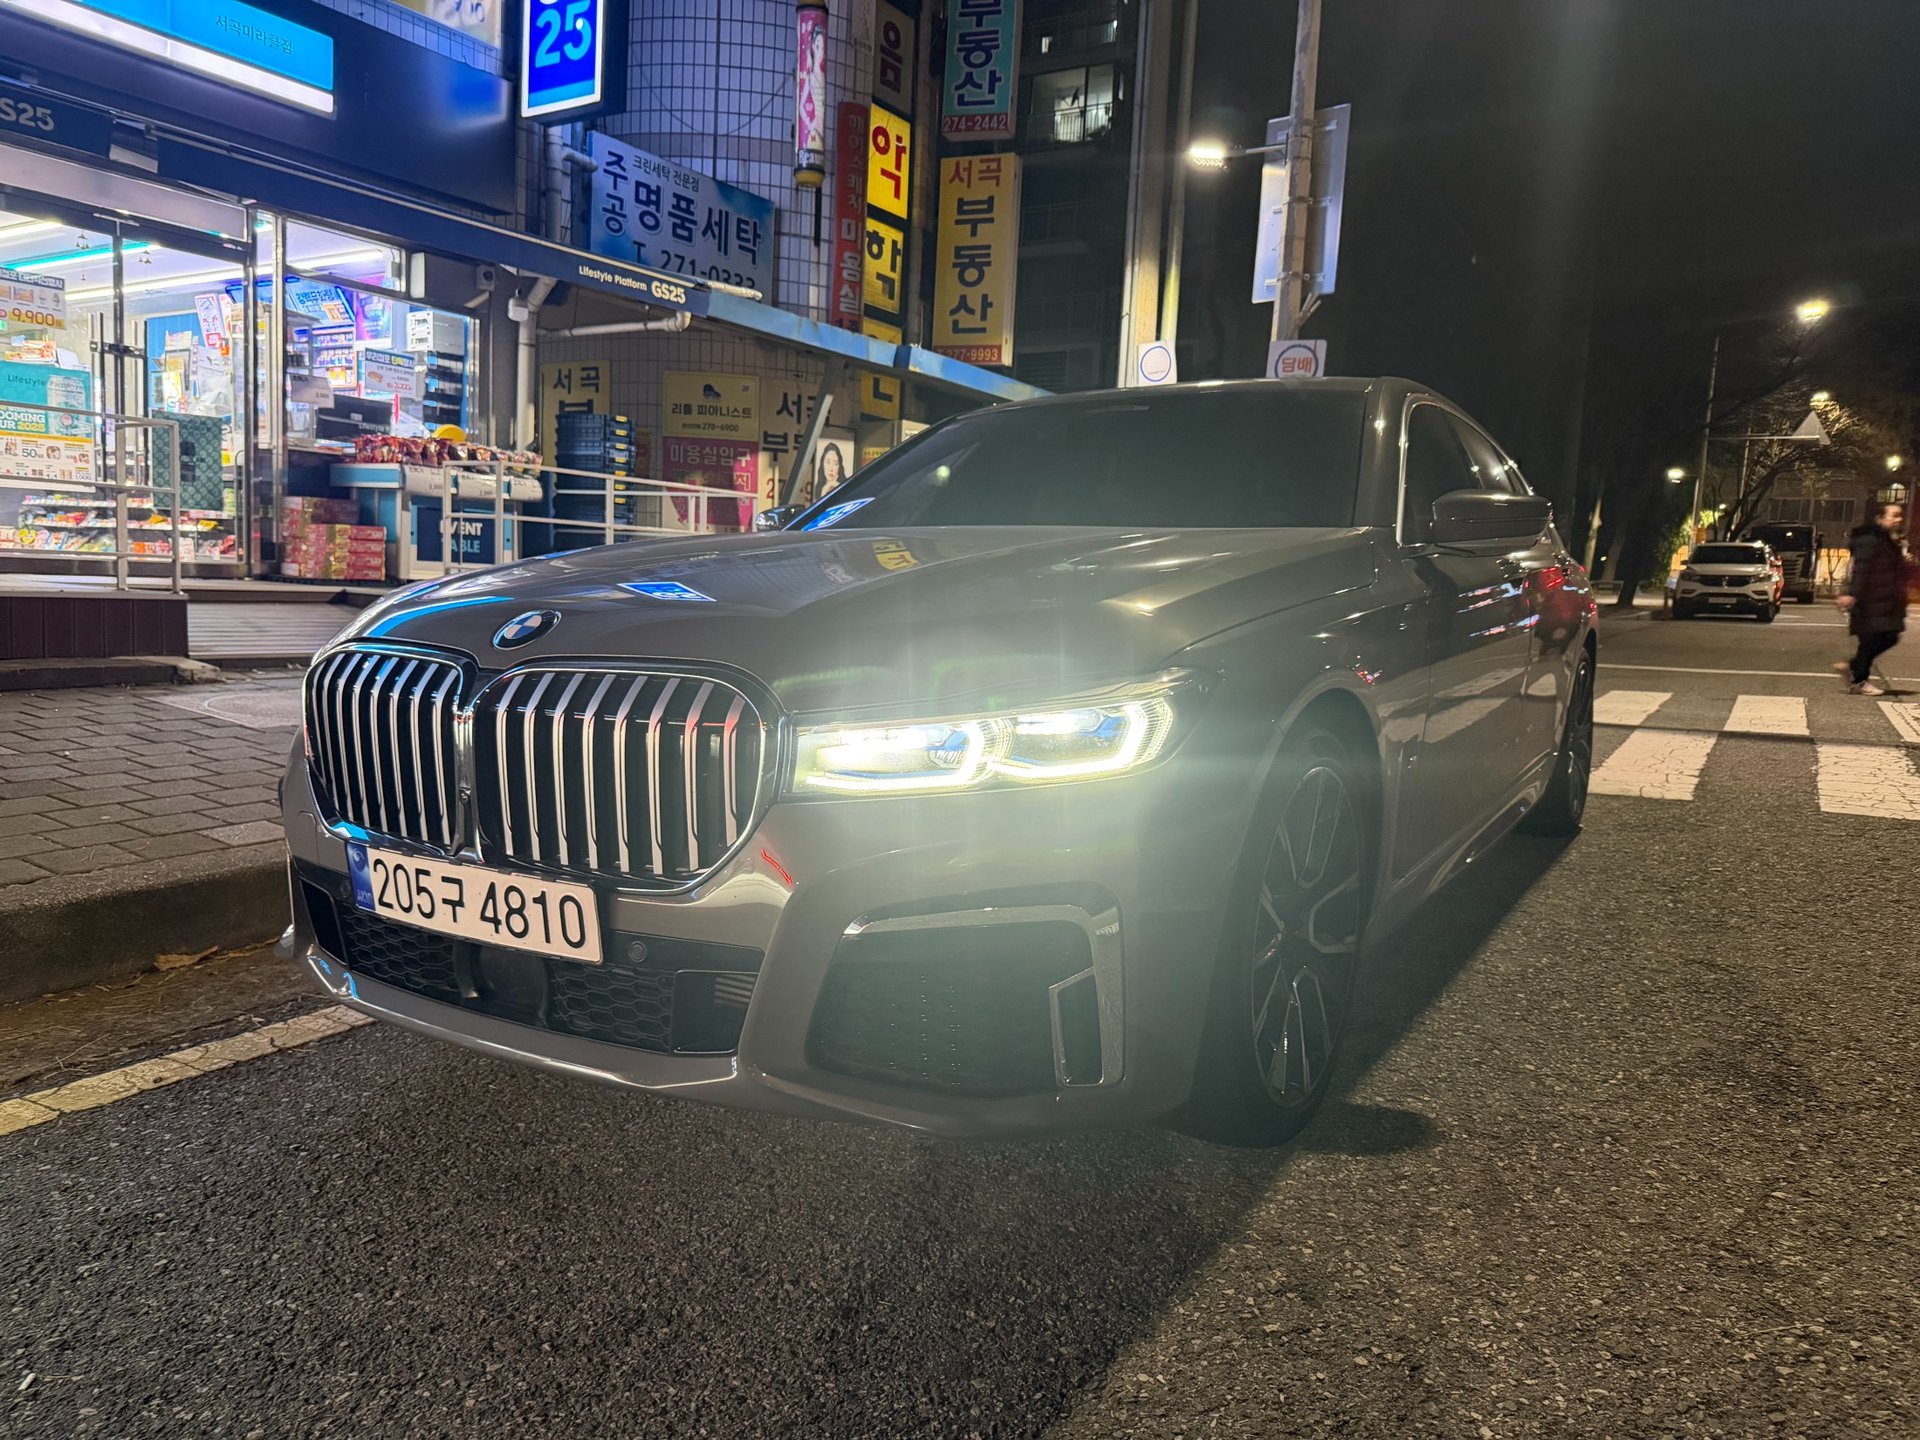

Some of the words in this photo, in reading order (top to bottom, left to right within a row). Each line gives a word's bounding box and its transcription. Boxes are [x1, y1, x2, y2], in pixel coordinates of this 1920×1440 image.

[216, 15, 293, 56] 서곡미라클점
[535, 0, 592, 68] 25
[944, 114, 1008, 132] 274-2442
[632, 154, 671, 182] 크린세탁
[949, 157, 1002, 188] 서곡
[634, 180, 762, 266] 명품세탁
[840, 218, 862, 315] 미용실
[949, 195, 994, 334] 부동산
[579, 265, 613, 283] Lifestyle
[614, 274, 648, 292] Platform
[651, 280, 686, 305] GS25
[1281, 356, 1313, 373] 담배
[7, 374, 46, 387] Lifestyle
[553, 366, 600, 395] 서곡
[697, 404, 752, 419] 피아니스트
[670, 444, 751, 468] 미용실입구
[373, 858, 465, 923] 205구
[479, 881, 586, 949] 4810
